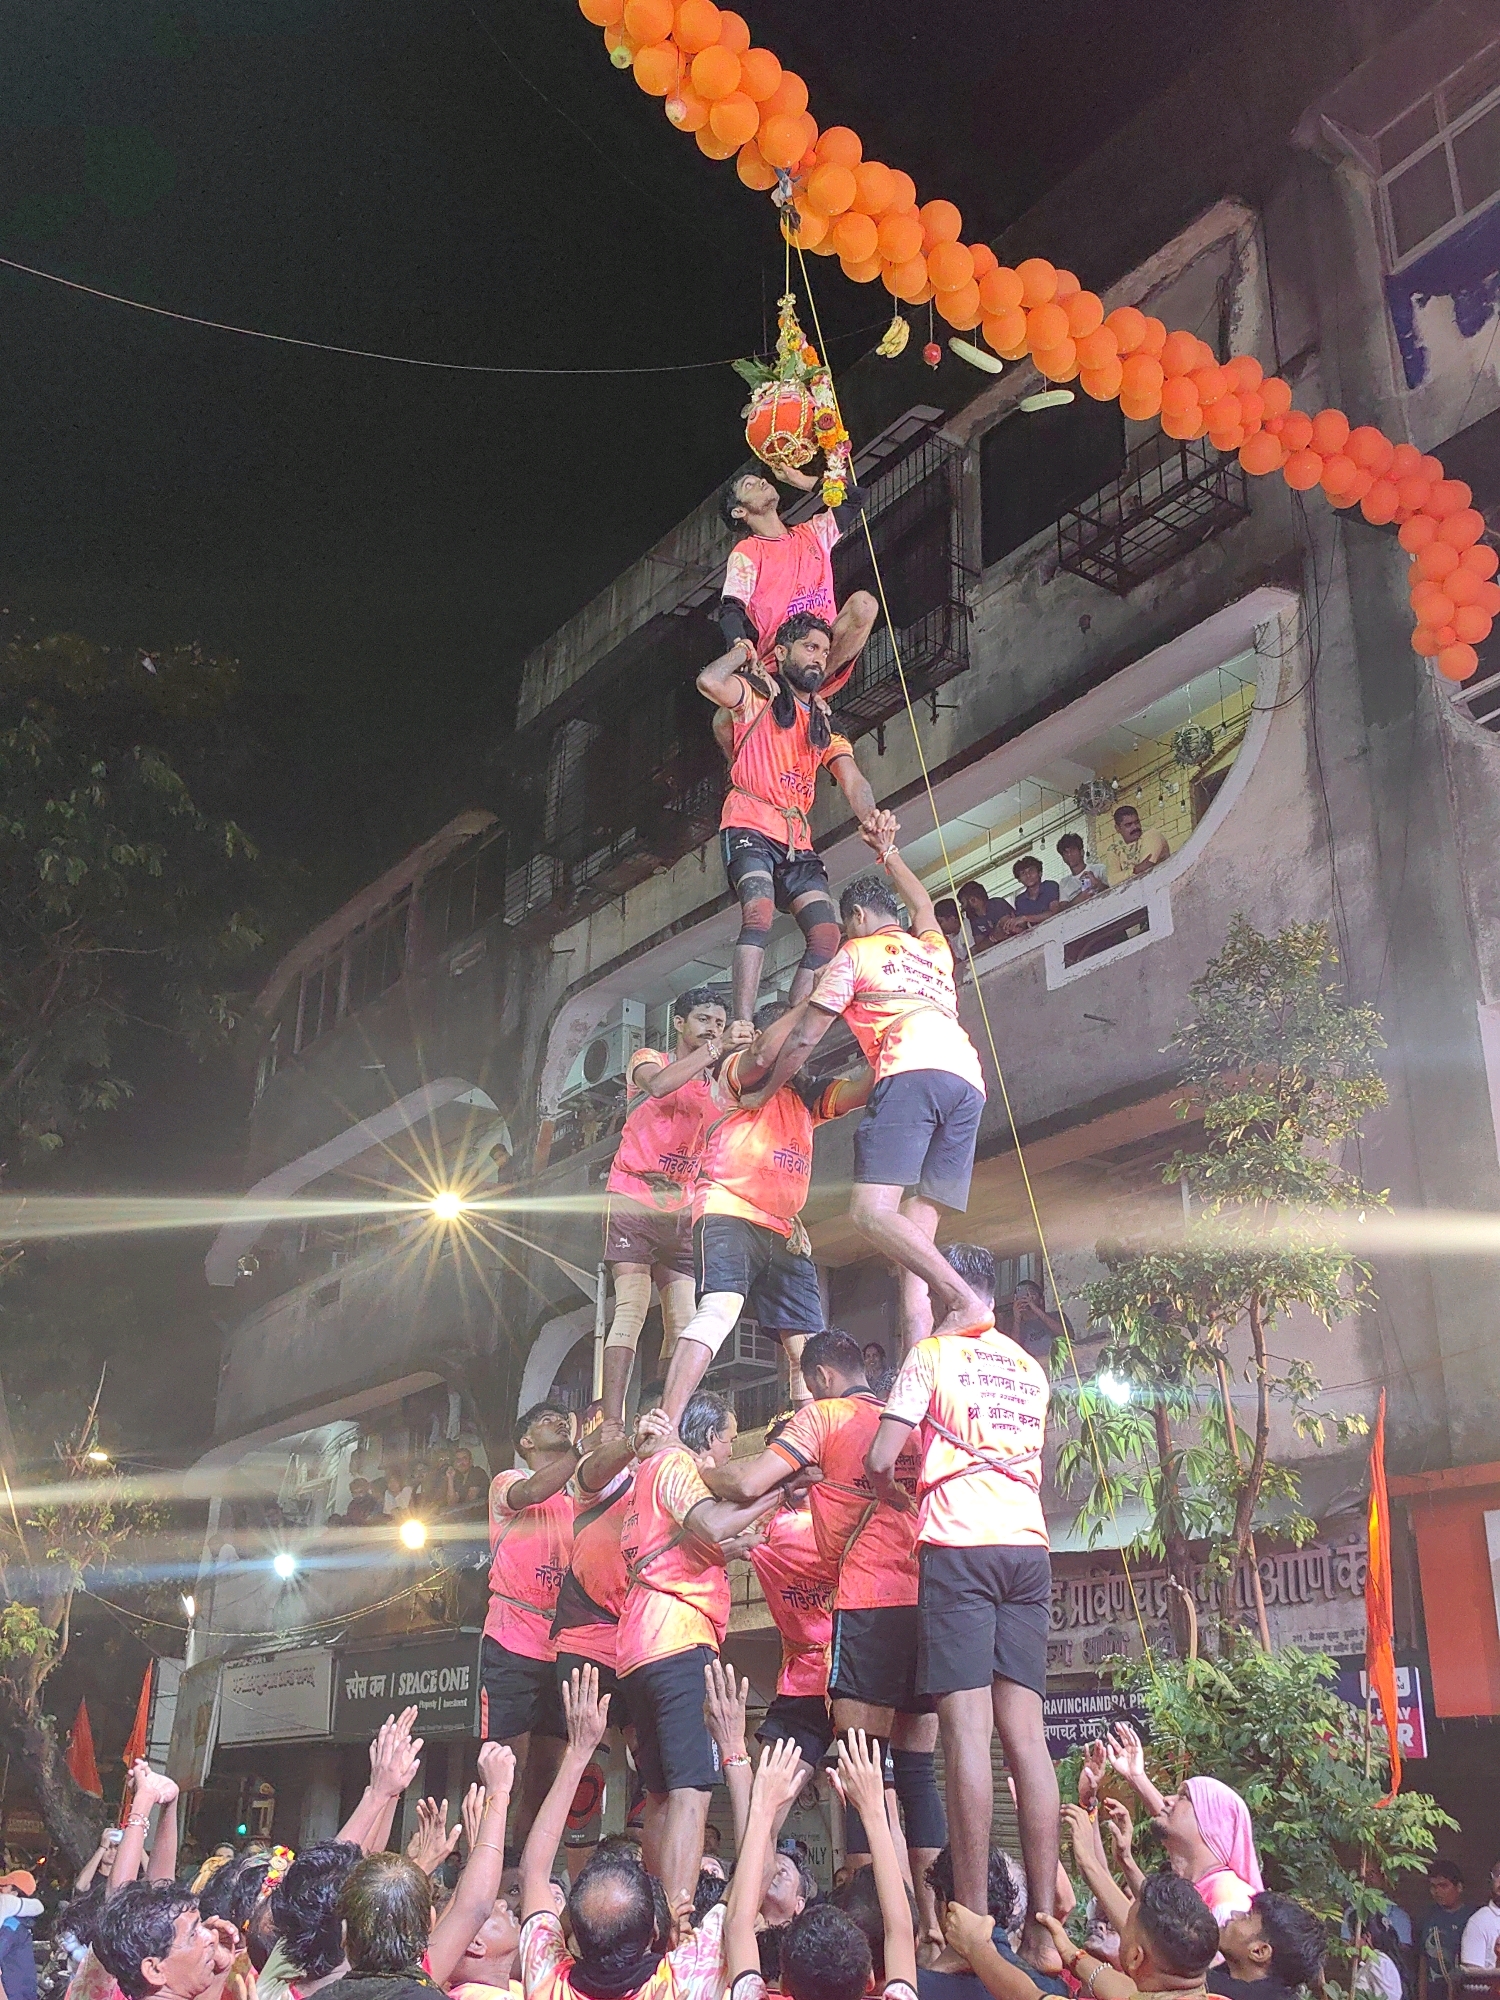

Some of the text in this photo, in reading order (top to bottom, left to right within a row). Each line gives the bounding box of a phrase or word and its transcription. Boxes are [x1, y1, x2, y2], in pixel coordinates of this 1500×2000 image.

[398, 1665, 470, 1696] SPACE ONE
[1043, 1694, 1126, 1715] RAVINCHANDRA
